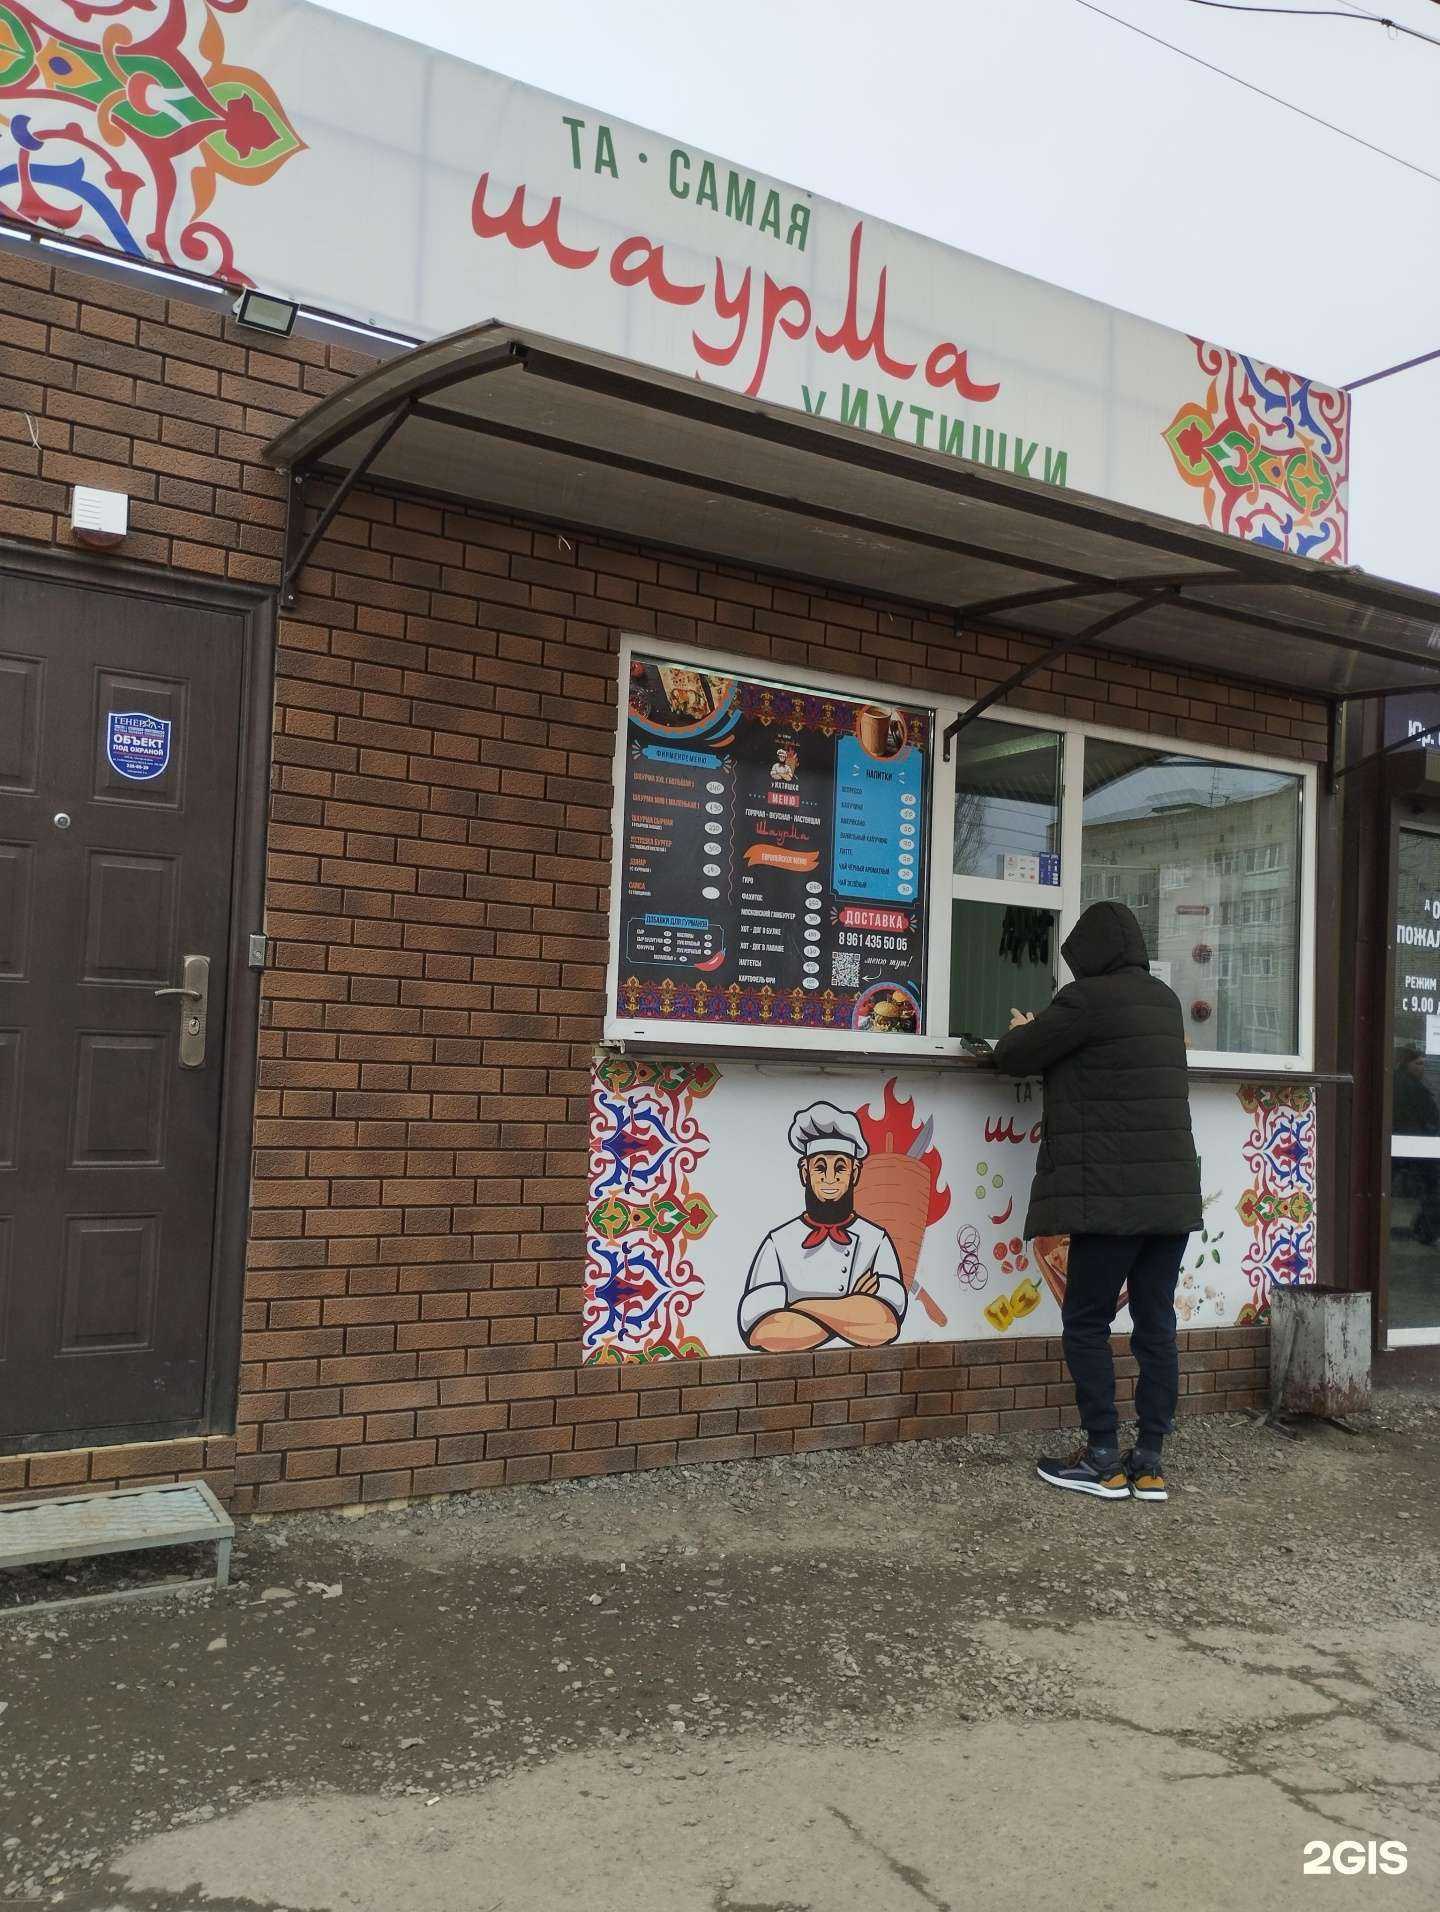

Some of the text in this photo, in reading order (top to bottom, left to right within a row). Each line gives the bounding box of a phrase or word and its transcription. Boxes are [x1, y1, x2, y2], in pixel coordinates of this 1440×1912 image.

[562, 115, 812, 252] ТА САМАЯ
[113, 733, 164, 749] ОБЪЕКТ
[113, 744, 164, 756] ПОД ОХРАНОЙ
[866, 769, 893, 781] НАПИТКИ
[772, 793, 796, 806] МЕНЮ
[745, 808, 766, 818] ГОРЯЧАЯ
[769, 811, 791, 822] ВКУСНАЯ
[845, 910, 903, 929] ДОСТАВКА
[838, 931, 908, 951] 8 961 435 50 05
[864, 956, 913, 970] меню тут!
[1405, 975, 1437, 991] РЕЖИМ
[1411, 996, 1434, 1013] 9.00
[1014, 1082, 1032, 1103] ТА
